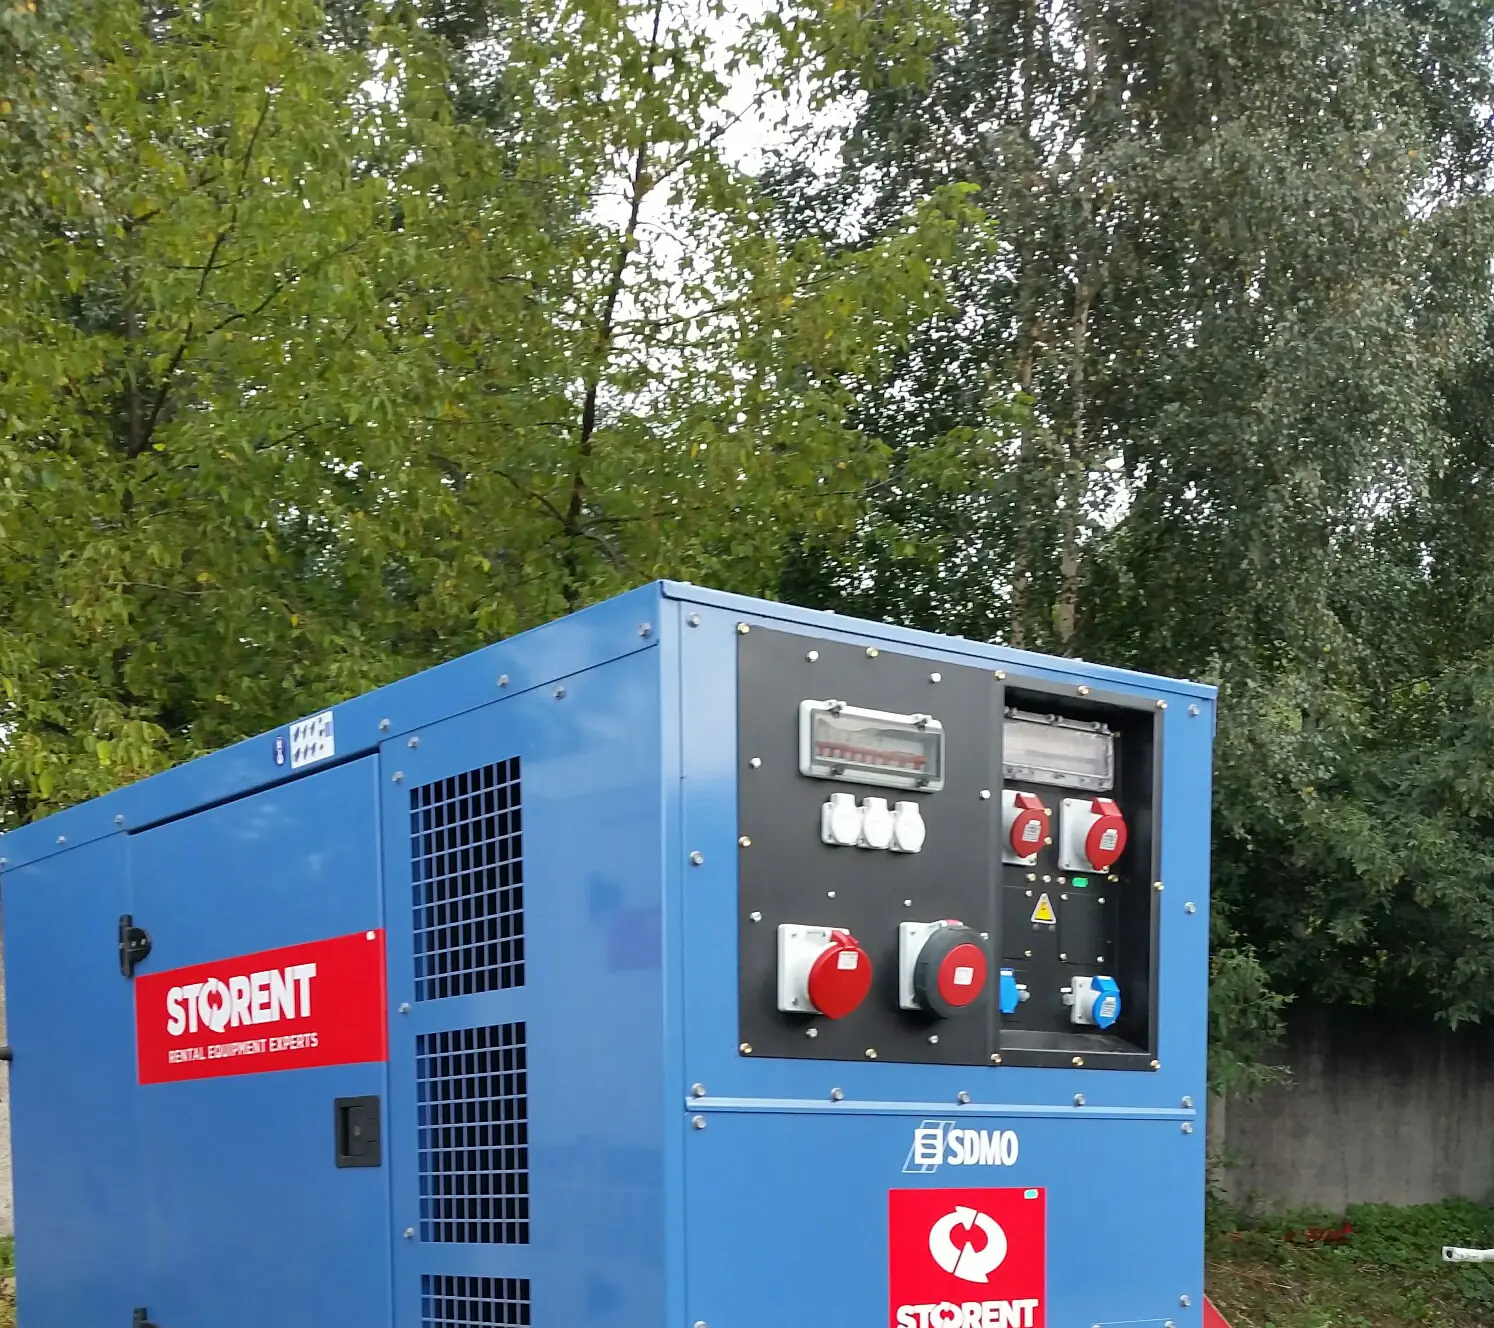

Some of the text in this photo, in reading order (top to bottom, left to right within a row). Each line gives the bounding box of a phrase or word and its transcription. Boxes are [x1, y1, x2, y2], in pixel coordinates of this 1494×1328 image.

[166, 963, 317, 1036] STORENT
[168, 1032, 318, 1064] RENTAL EQUIPMENT EXPERTS
[947, 1129, 1019, 1166] SDMO
